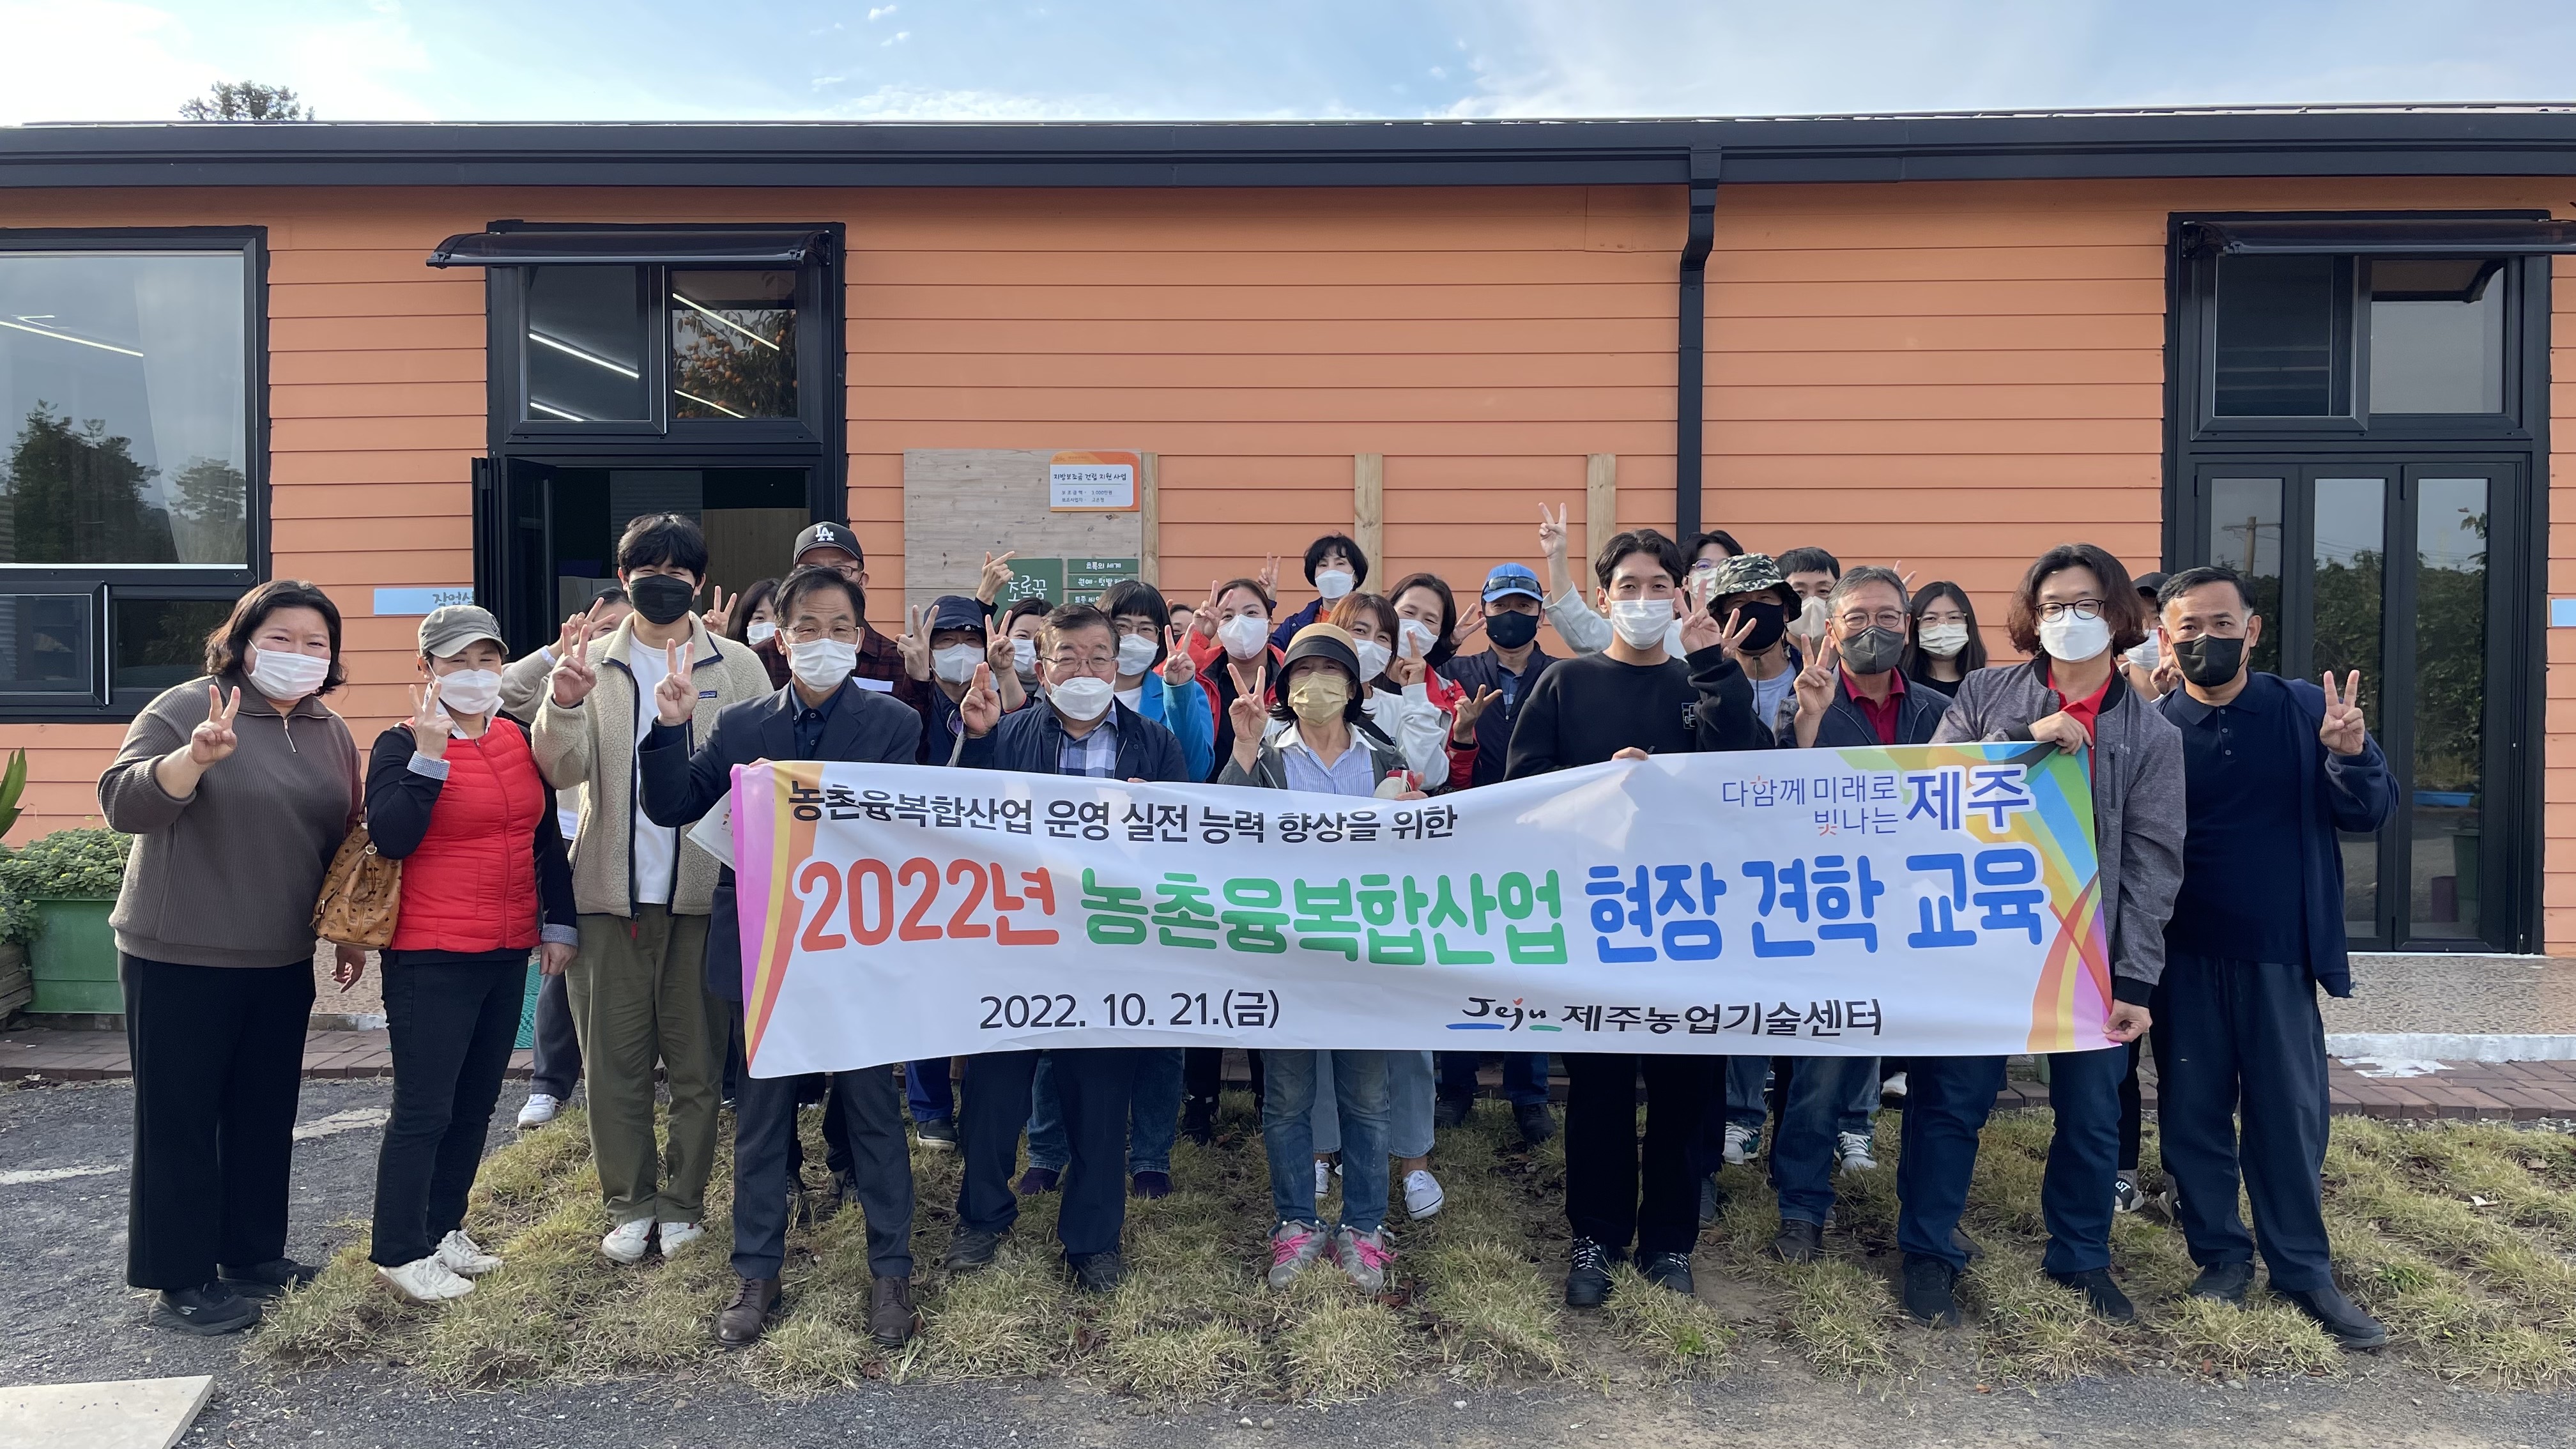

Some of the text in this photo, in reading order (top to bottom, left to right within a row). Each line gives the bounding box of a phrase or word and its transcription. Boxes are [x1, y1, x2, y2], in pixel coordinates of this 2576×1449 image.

[1099, 472, 1112, 481] 지원
[1113, 473, 1126, 481] 사업
[815, 525, 834, 541] LA
[1722, 774, 1897, 808] 다함께 미래로
[1905, 768, 2030, 831] 제주
[788, 780, 1458, 845] 농촌융복합산업 운영 실전 능력 향상을 위한
[1813, 806, 1899, 836] 빛나는
[799, 847, 2044, 966] 2022년 농촌융복합산업 현장 견학 교육
[980, 988, 1280, 1030] 2022. 10. 21.(금)
[1561, 998, 1882, 1038] 제주농업기술센터
